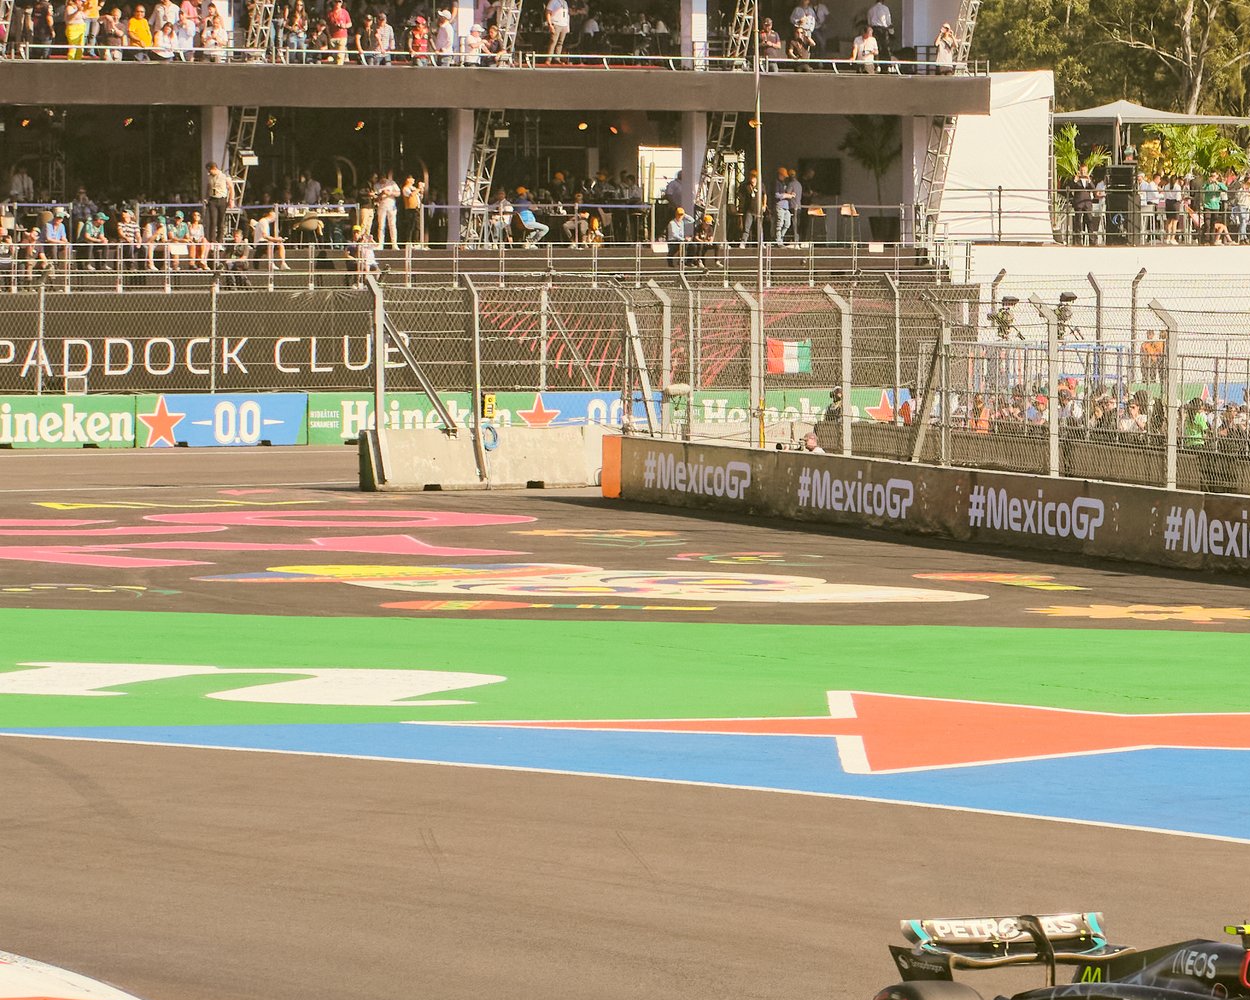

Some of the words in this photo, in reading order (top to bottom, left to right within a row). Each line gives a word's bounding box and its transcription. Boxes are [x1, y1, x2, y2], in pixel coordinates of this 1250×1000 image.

[214, 401, 261, 445] 0.0
[644, 452, 750, 500] #MexicoGP
[799, 468, 914, 520] #MexicoGP
[969, 485, 1104, 541] #MexicoGP
[934, 917, 1078, 939] PETROAS
[1172, 950, 1219, 979] INEOS
